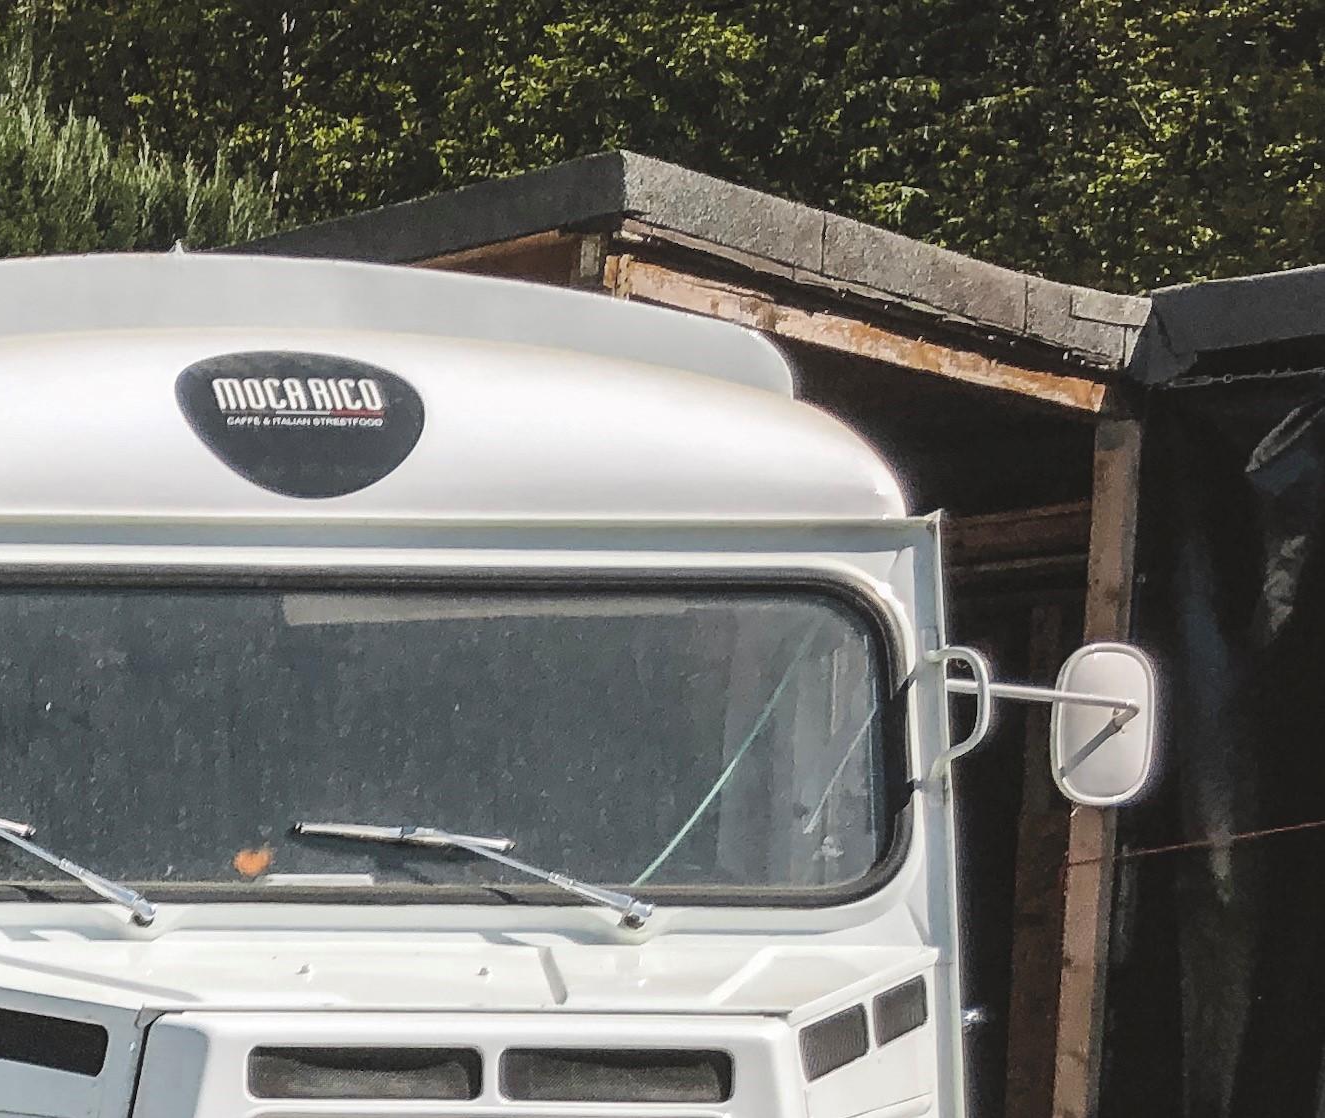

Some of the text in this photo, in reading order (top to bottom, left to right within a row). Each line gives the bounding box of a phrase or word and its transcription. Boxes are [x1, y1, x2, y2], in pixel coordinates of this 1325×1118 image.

[212, 378, 384, 410] MOCA RICO
[263, 417, 271, 426] &
[272, 417, 311, 426] ITALIAN
[312, 417, 384, 427] STREETFOOD
